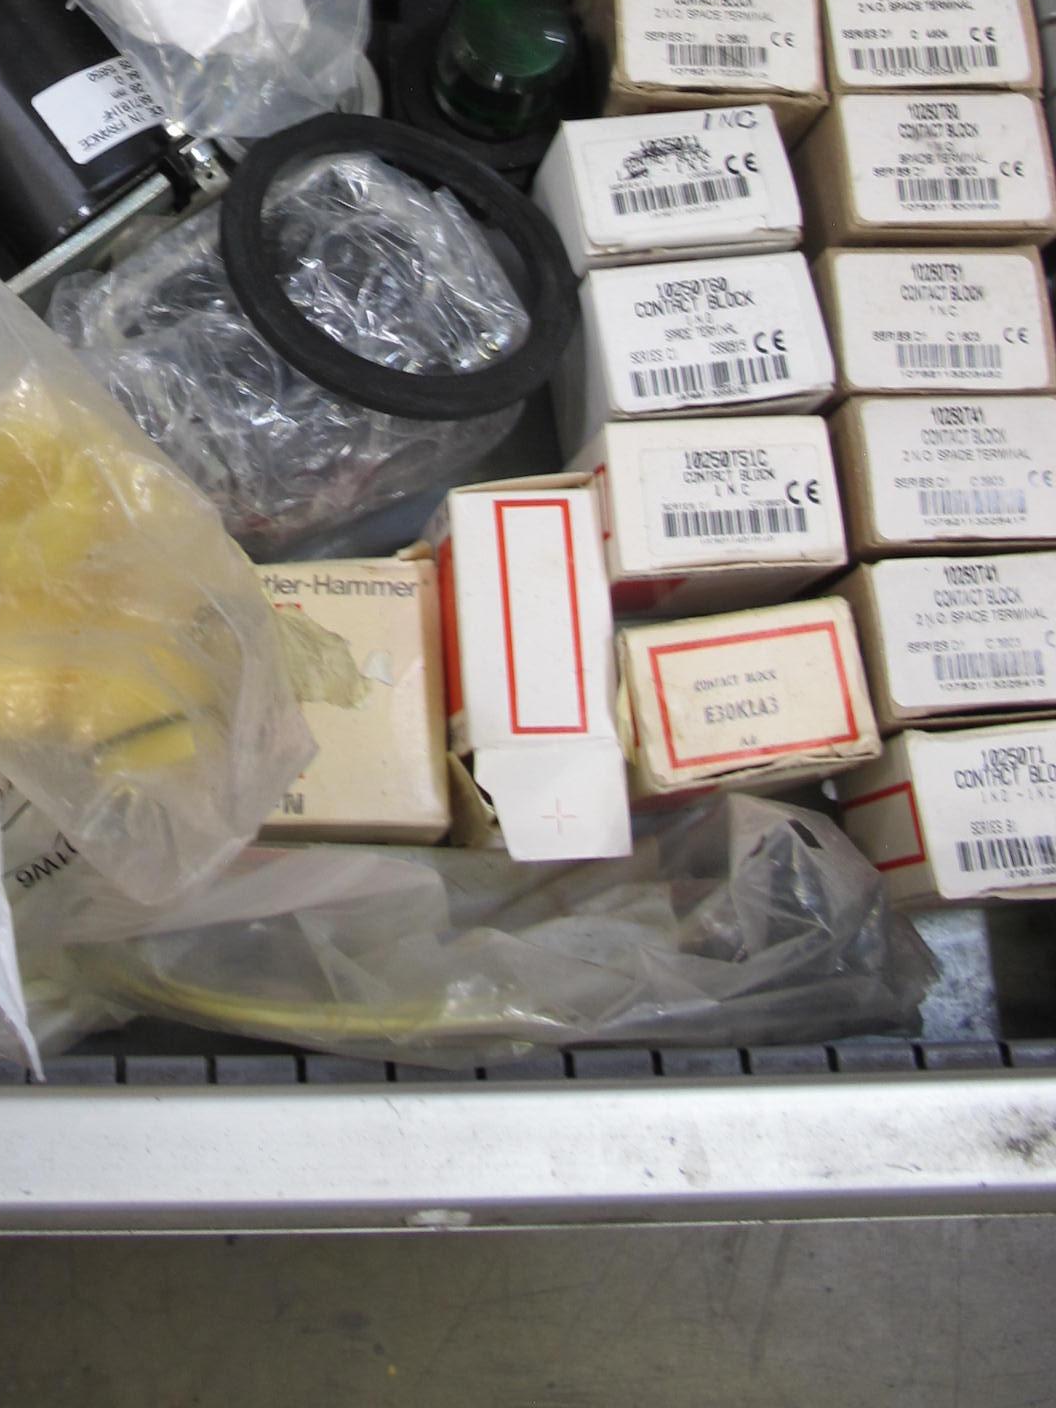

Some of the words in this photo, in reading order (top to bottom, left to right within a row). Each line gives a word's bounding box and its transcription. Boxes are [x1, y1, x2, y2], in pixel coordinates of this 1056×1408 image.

[724, 11, 777, 23] TERMINAL
[898, 123, 943, 140] CONTACT
[946, 123, 980, 139] BLOCK
[900, 285, 947, 302] CONTACT
[950, 285, 986, 302] BLOCK
[634, 294, 699, 318] CONTACT
[707, 289, 757, 310] BLOCK
[921, 429, 968, 446] CONTACT
[972, 428, 1009, 445] BLOCK
[684, 449, 770, 470] 10250T51C
[937, 449, 975, 461] SPACE
[977, 448, 1032, 461] TERMINAL
[683, 469, 734, 485] CONTACT
[739, 467, 778, 482] BLOCK
[263, 573, 419, 600] tler-Hammer
[934, 587, 983, 608] CONTACT
[986, 585, 1025, 606] BLOCK
[951, 609, 990, 624] SPACE
[992, 607, 1048, 622] TERMINAL
[693, 672, 740, 692] CONTACT
[954, 763, 1022, 790] CONTACT
